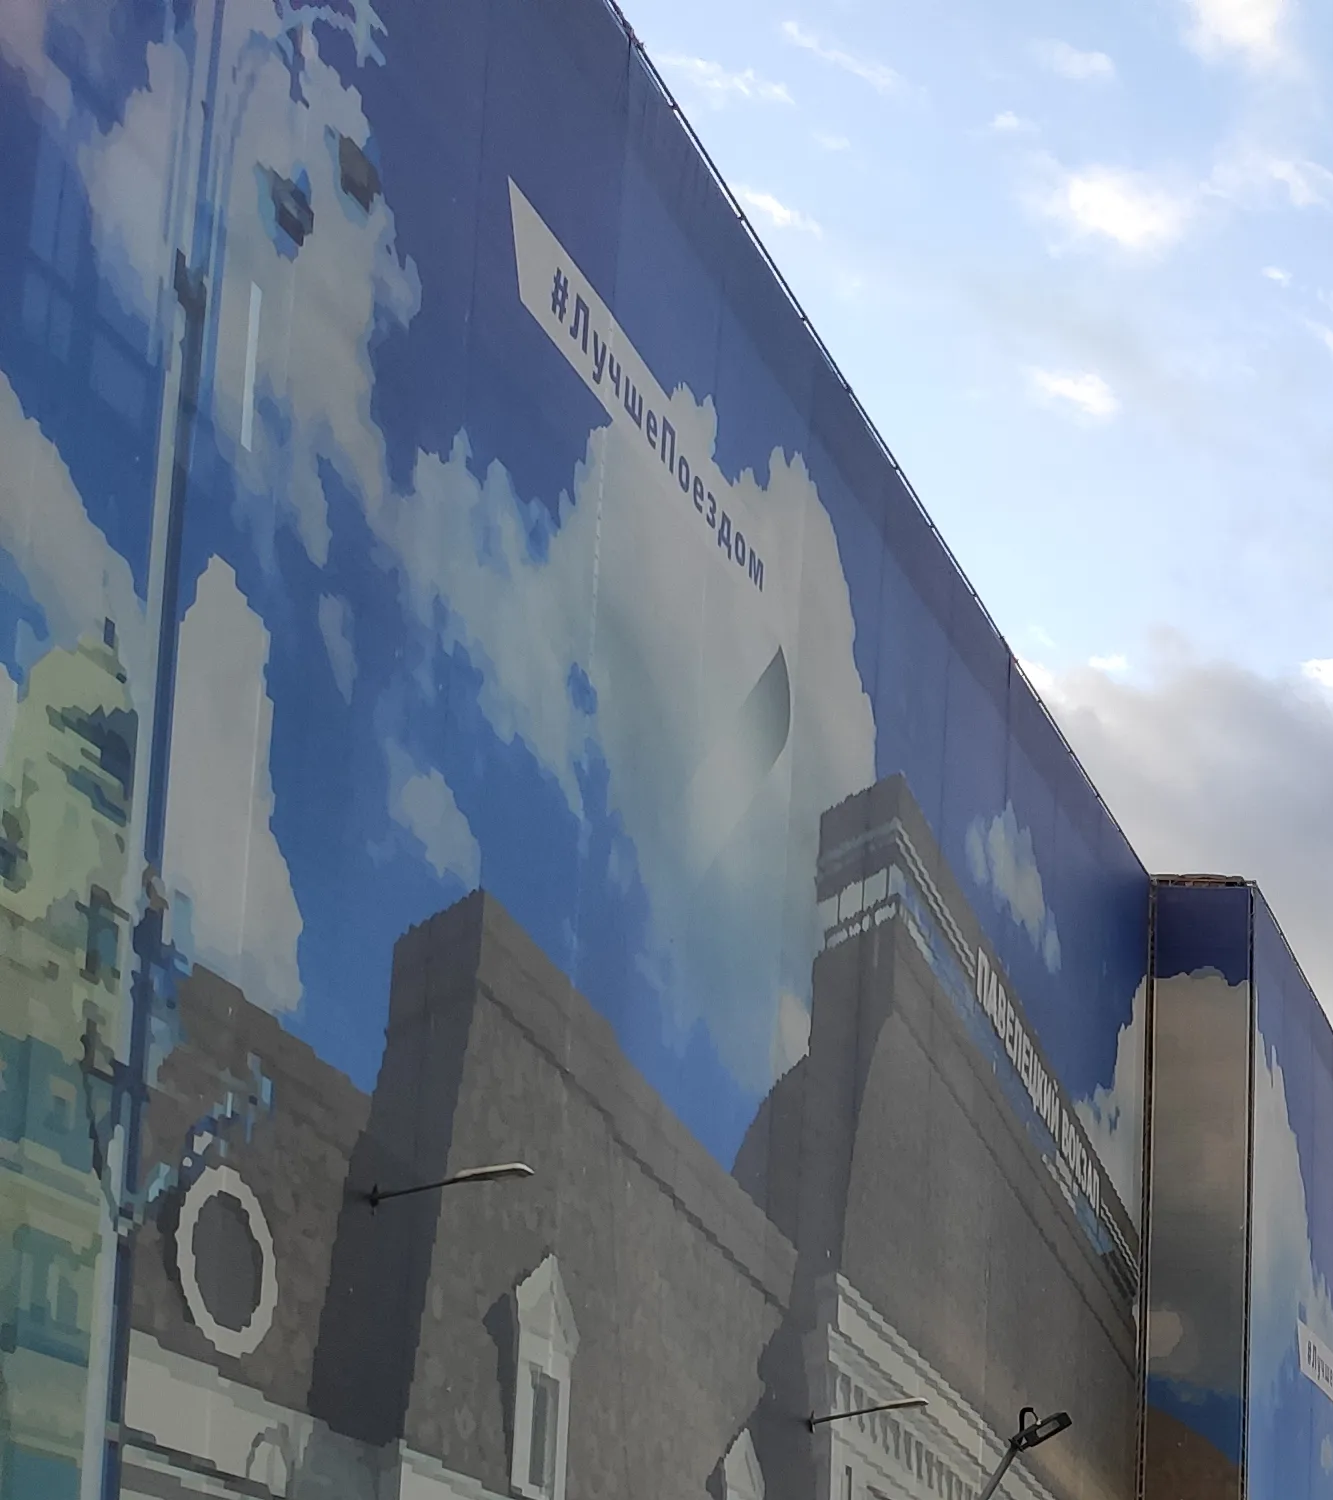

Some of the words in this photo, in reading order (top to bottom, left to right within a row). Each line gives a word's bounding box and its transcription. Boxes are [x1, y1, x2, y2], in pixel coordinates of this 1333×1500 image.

[551, 266, 765, 592] #ЛучшеПоездом
[976, 946, 1060, 1143] ПАВЕЛЕЦКИЙ
[1061, 1107, 1101, 1218] ВОКЗАЛ
